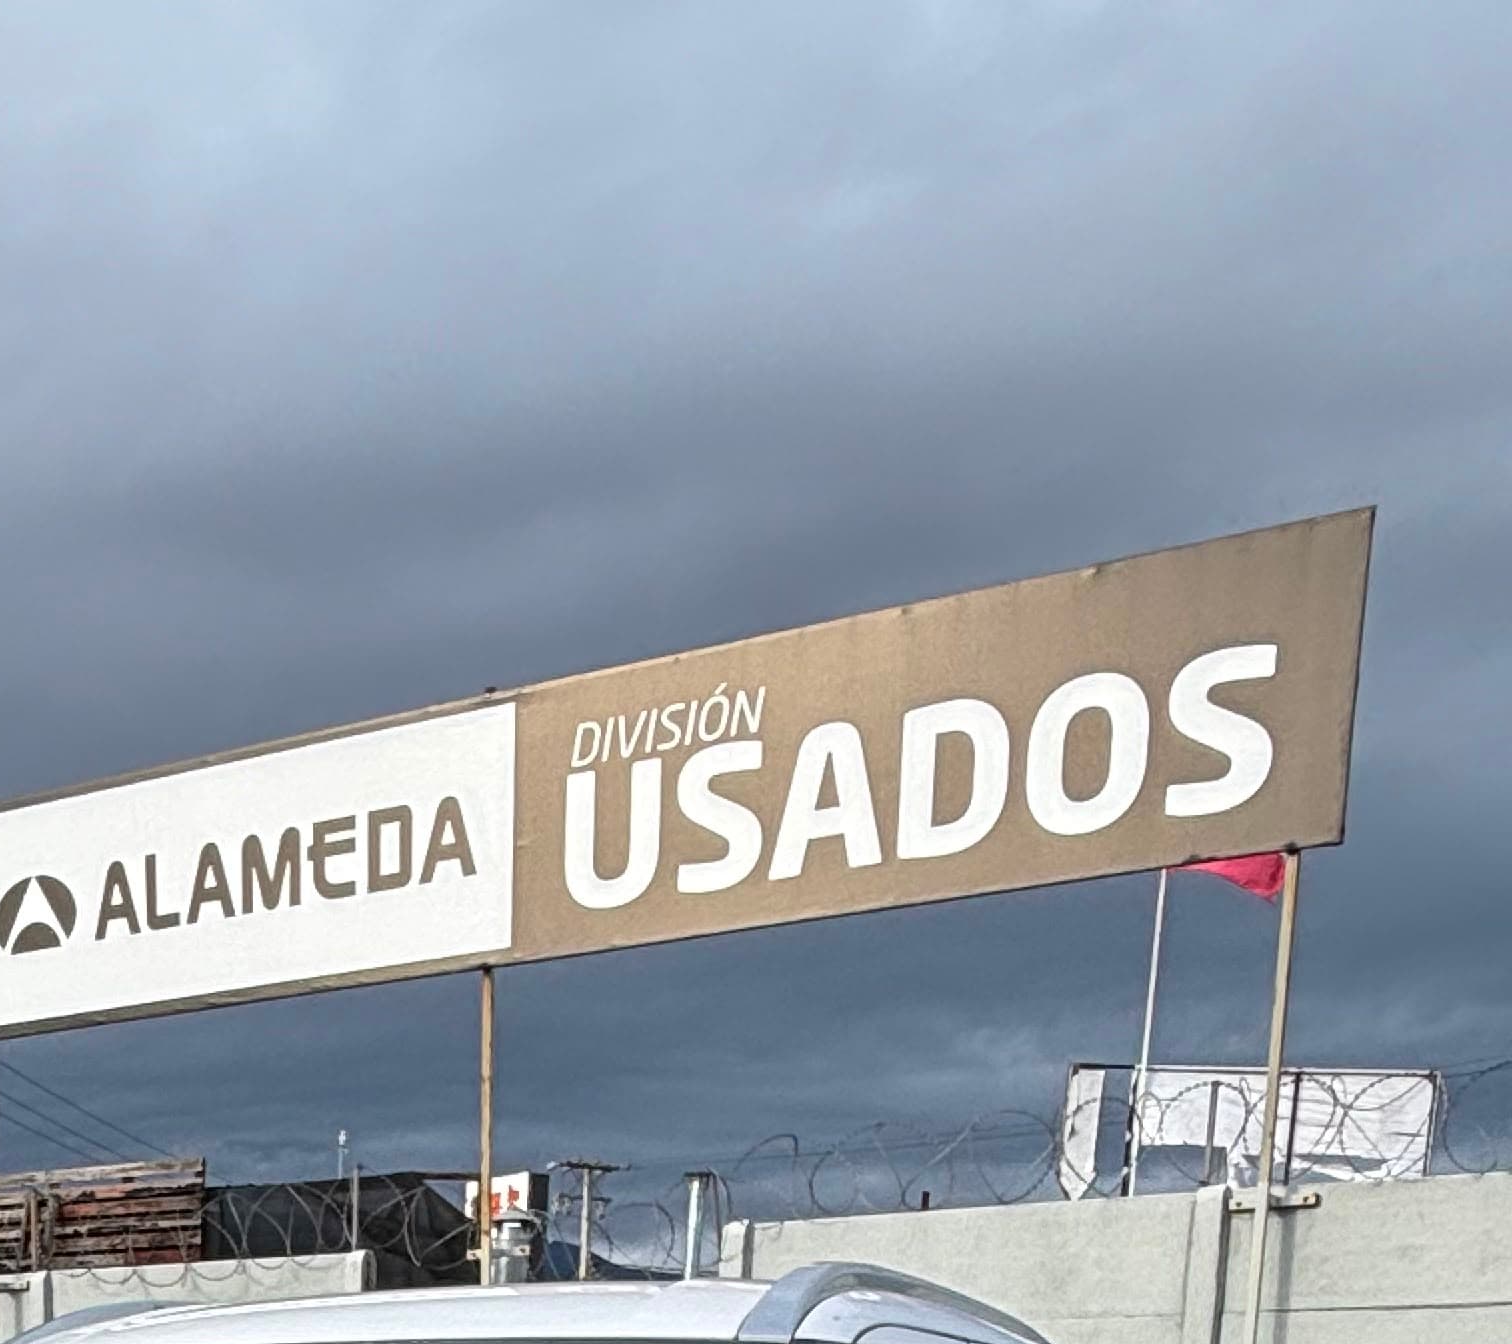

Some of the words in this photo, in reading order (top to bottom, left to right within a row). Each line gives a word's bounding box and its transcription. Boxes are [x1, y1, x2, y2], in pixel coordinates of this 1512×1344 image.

[564, 643, 1278, 909] USADOS
[570, 682, 767, 768] DIVISIÓN
[94, 795, 477, 942] ALAMEDA
